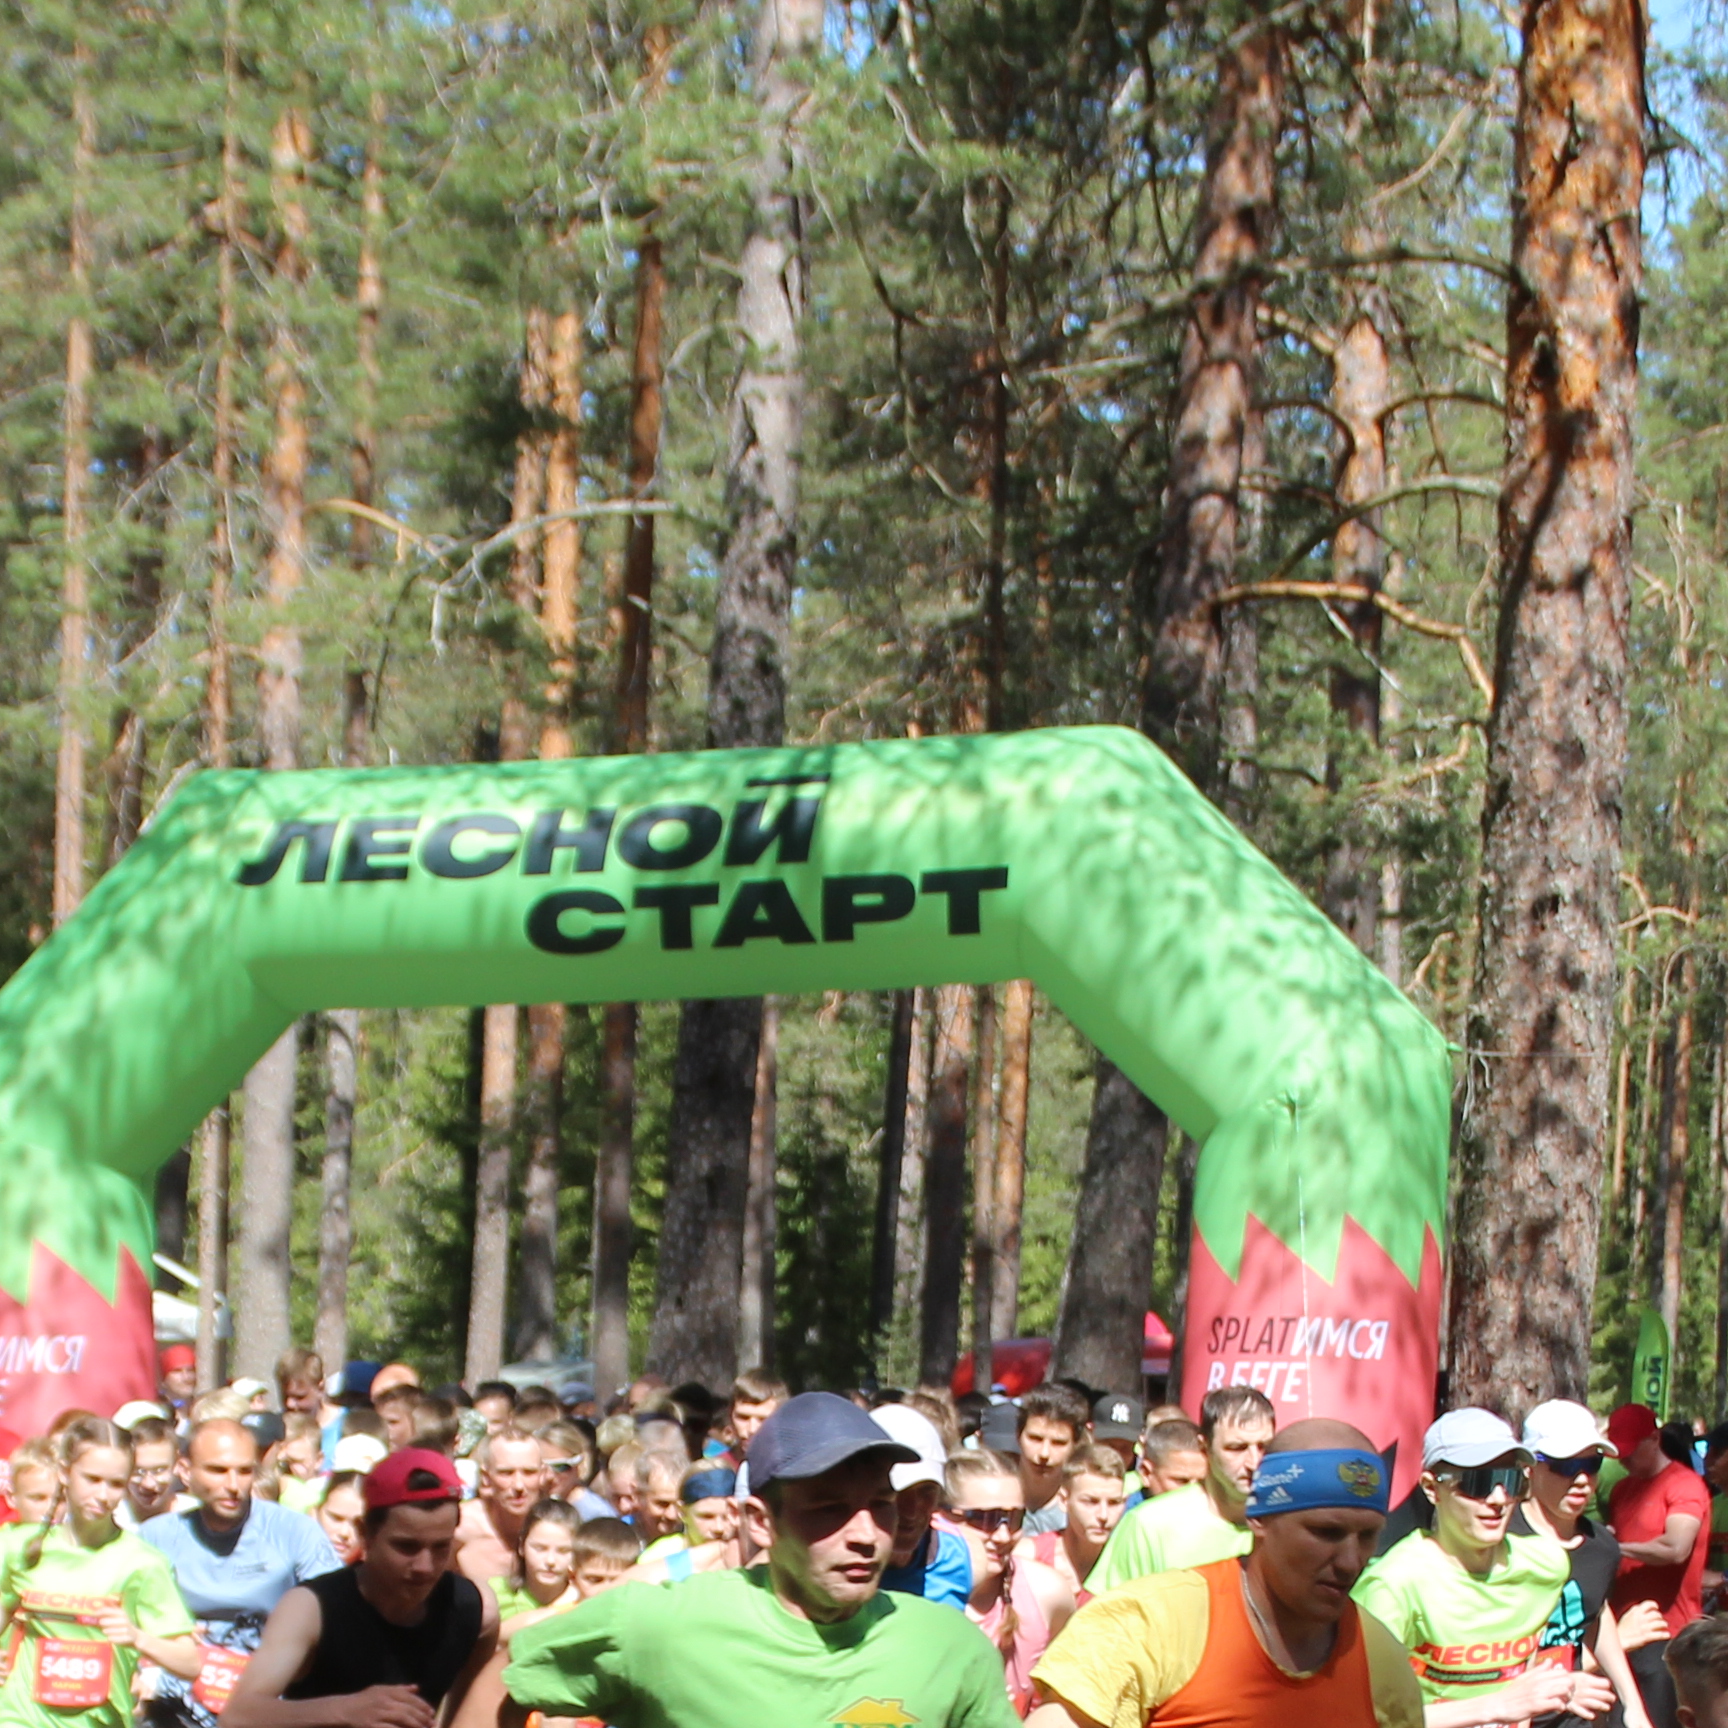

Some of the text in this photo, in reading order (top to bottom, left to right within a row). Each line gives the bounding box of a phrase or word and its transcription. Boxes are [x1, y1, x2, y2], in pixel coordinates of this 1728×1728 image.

[236, 773, 831, 885] ЛЕСНОЙ
[524, 865, 1009, 955] СТАРТ
[1207, 1315, 1390, 1361] SPLATИМСЯ
[40, 1656, 101, 1680] 5489
